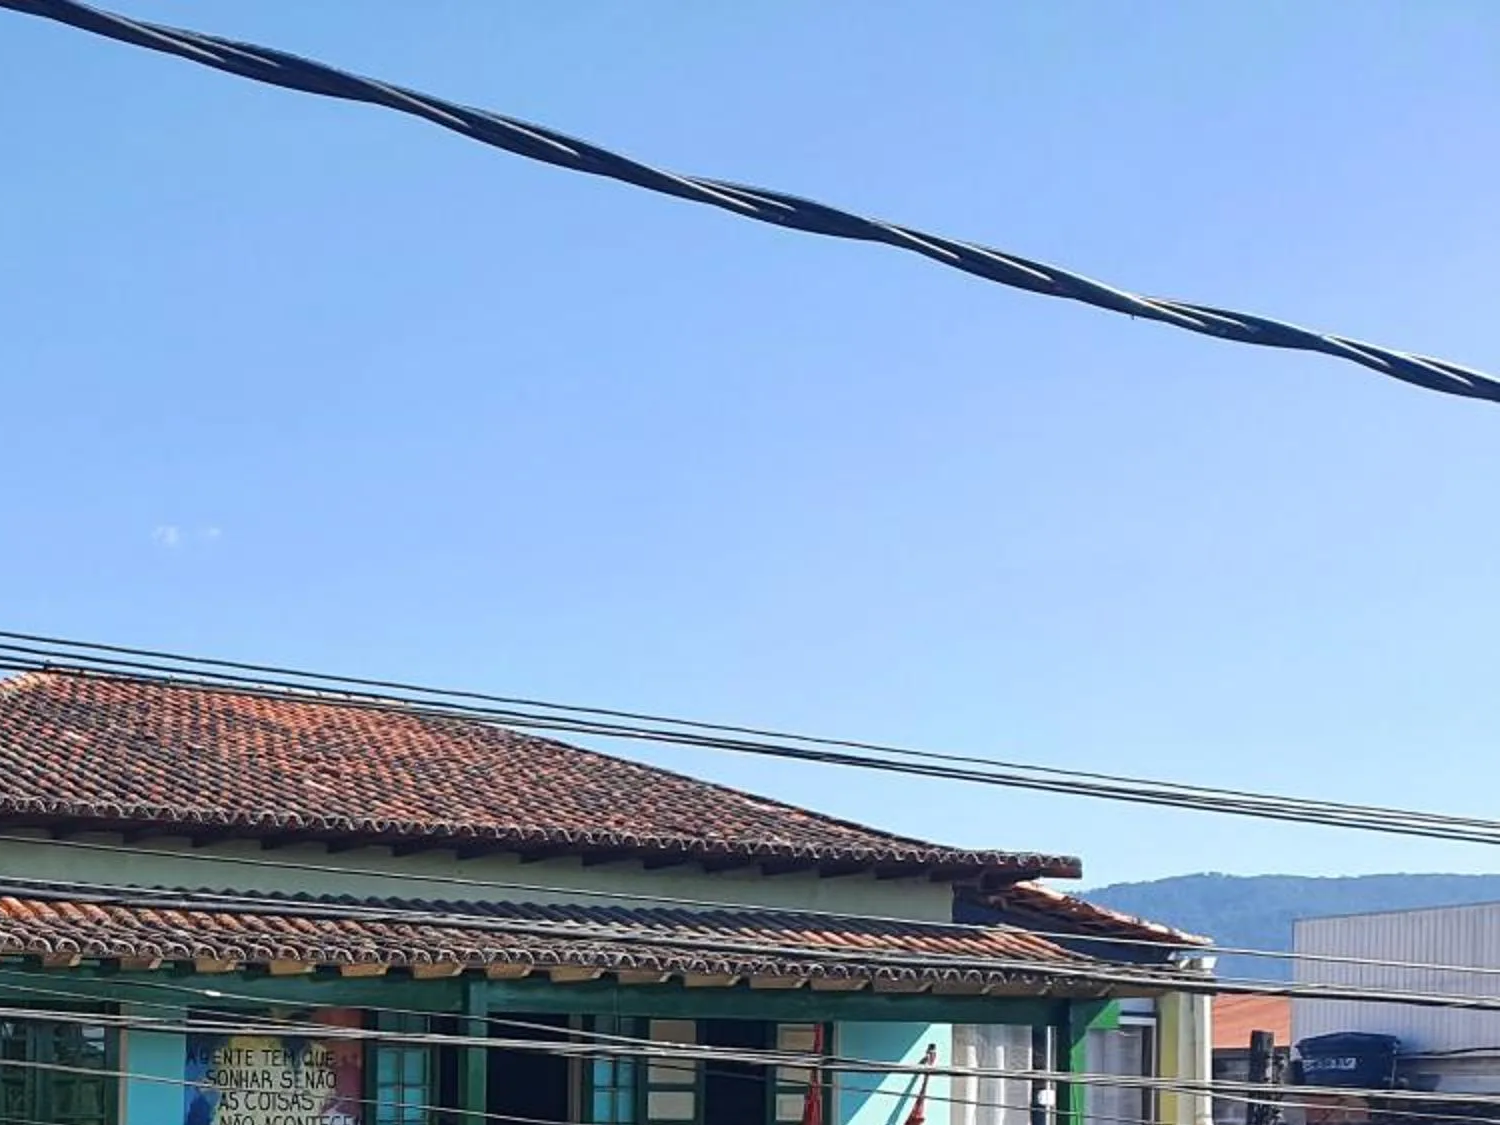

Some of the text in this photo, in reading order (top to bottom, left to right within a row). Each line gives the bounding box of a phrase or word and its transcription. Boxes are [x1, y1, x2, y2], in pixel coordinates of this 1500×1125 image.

[261, 1048, 295, 1067] TEM
[303, 1048, 335, 1067] QUE
[204, 1069, 272, 1089] SONHAR
[219, 1091, 239, 1111] AS
